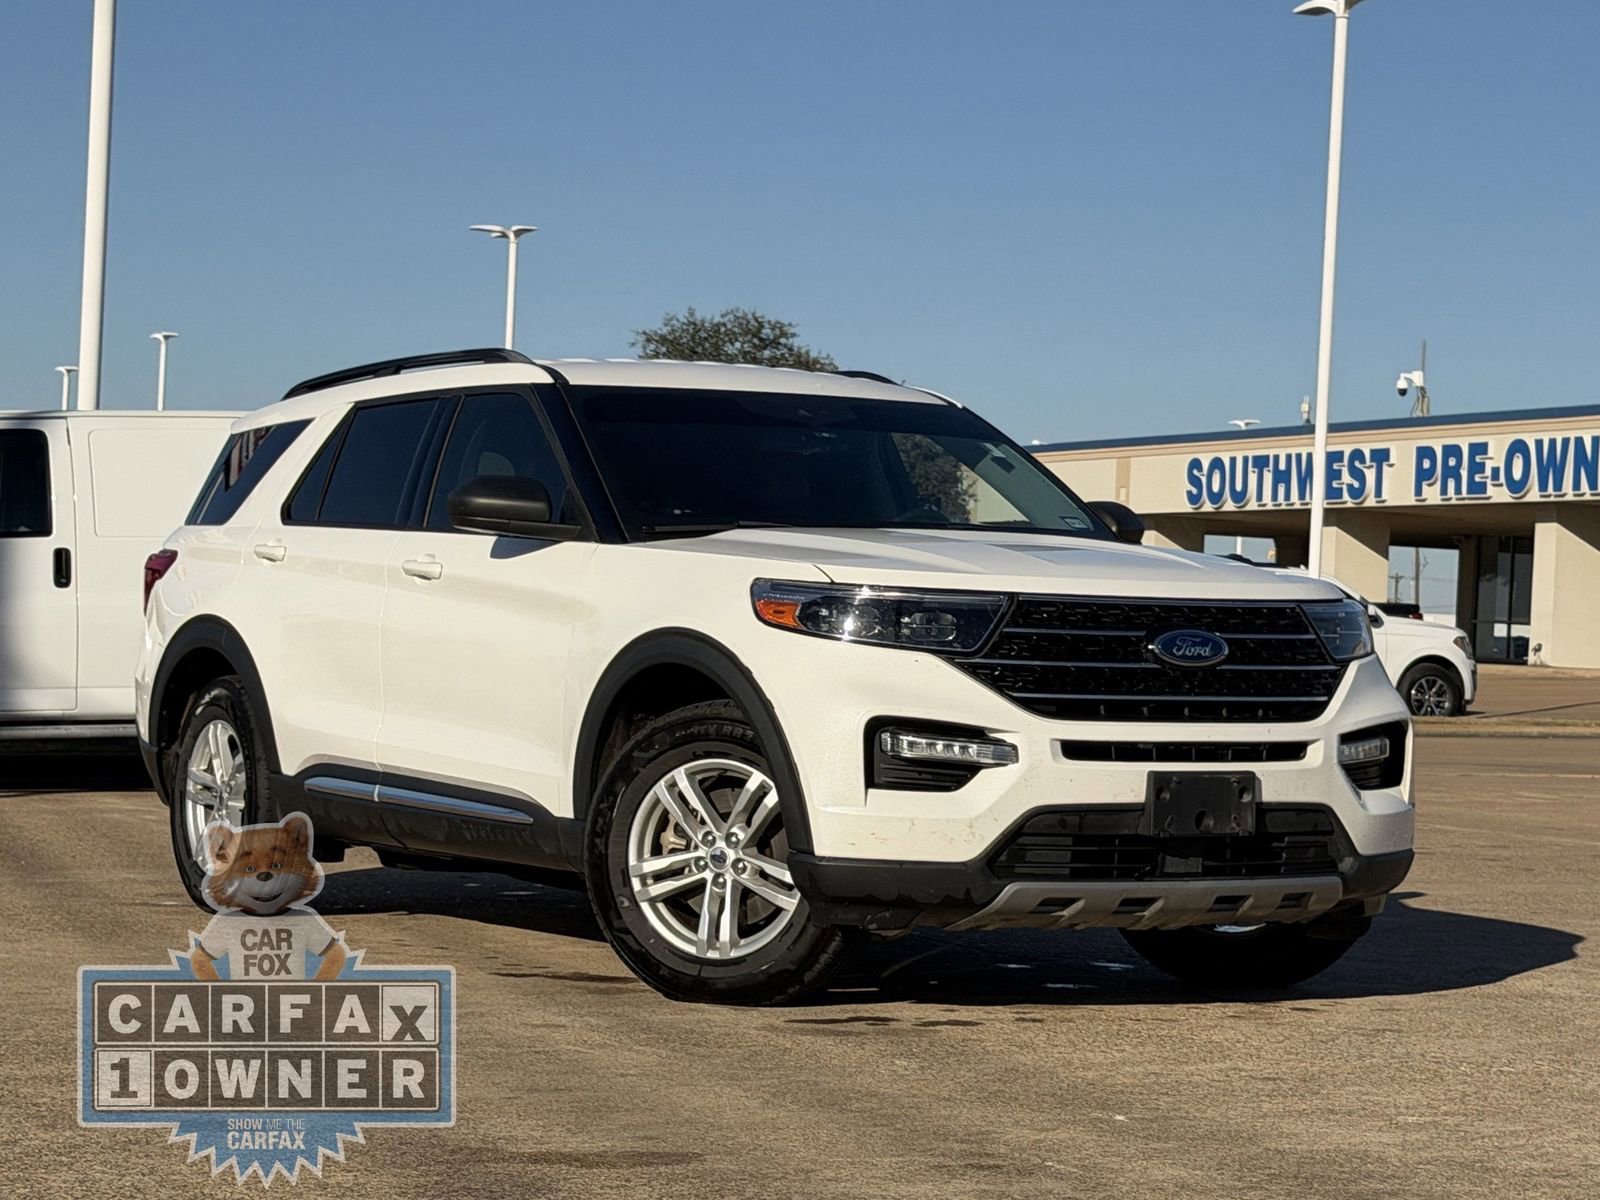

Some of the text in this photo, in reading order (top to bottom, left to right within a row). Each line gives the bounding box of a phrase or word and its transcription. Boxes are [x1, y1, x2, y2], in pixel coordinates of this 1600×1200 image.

[1186, 435, 1600, 507] SOUTHWEST PRE-OWN
[1172, 636, 1212, 656] Ford
